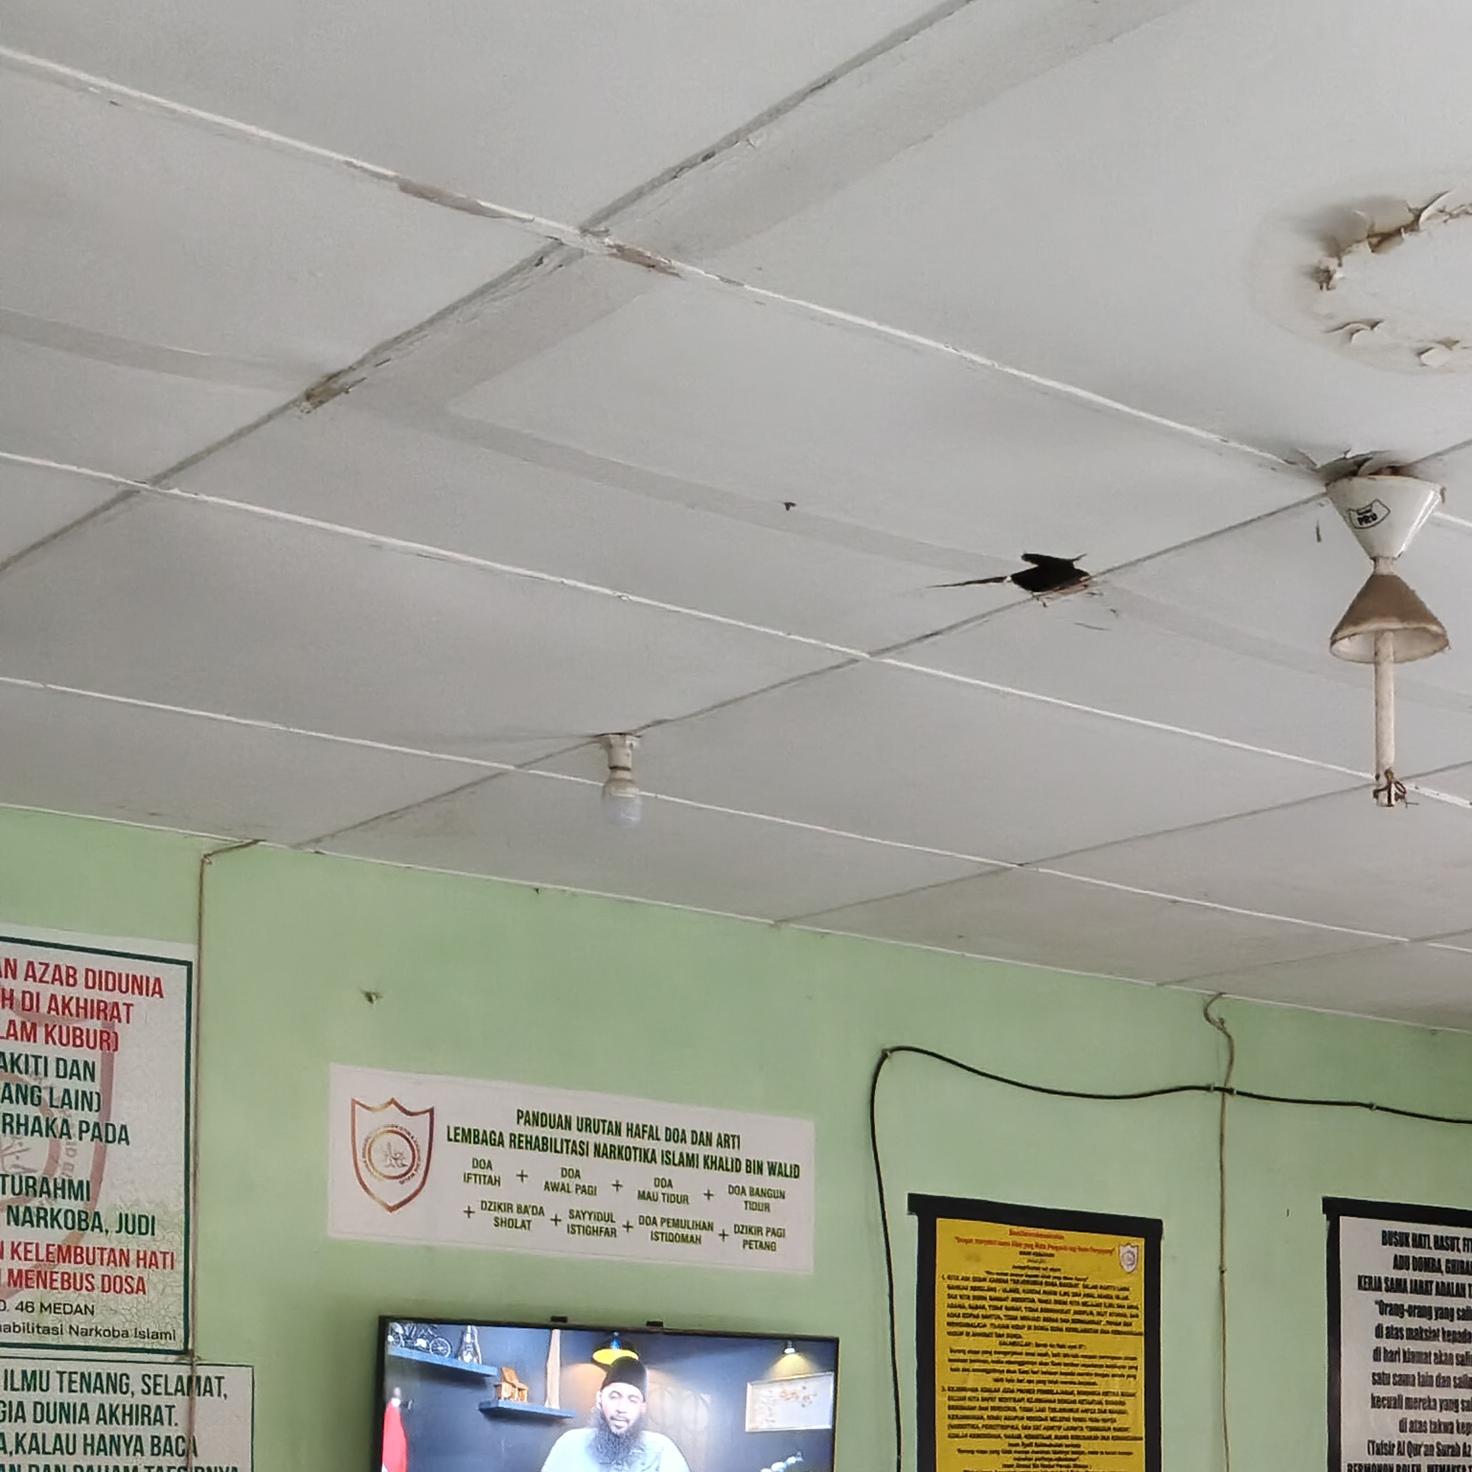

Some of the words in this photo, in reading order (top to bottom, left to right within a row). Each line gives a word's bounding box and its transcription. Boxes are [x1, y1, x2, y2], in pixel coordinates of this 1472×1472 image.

[24, 960, 77, 987] AZAB
[85, 968, 164, 998] DIDUNIA
[22, 990, 40, 1012] DI
[47, 993, 134, 1024] AKHIRAT
[45, 1023, 119, 1052] KUBUR)
[56, 1057, 95, 1082] DAN
[1, 1083, 41, 1106] ANG
[49, 1087, 101, 1112] LAIN)
[2, 1113, 71, 1139] RHAKA
[79, 1120, 129, 1145] PADA
[517, 1109, 571, 1131] PANDUAN
[577, 1116, 621, 1137] URUTAN
[626, 1122, 660, 1141] HAFAL
[665, 1127, 687, 1144] DOA
[691, 1130, 712, 1147] DAN
[716, 1134, 740, 1150] ARTI
[447, 1126, 504, 1148] LEMBAGA
[509, 1133, 589, 1156] REHABILITASI
[594, 1142, 657, 1164] NARKOTIKA
[661, 1150, 699, 1169] ISLAMI
[704, 1154, 741, 1173] KHALID
[746, 1159, 763, 1175] BIN
[768, 1161, 800, 1179] WALID
[464, 1172, 500, 1187] IFTITAH
[544, 1181, 571, 1193] AWAL
[575, 1184, 597, 1196] PAGI
[638, 1190, 658, 1202] MAU
[662, 1193, 689, 1205] TIDUR
[744, 1200, 770, 1212] TIDUR
[472, 1158, 492, 1170] DOA
[561, 1167, 581, 1180] DOA
[654, 1177, 673, 1189] DOA
[728, 1184, 746, 1196] DOA
[749, 1186, 786, 1199] BANGUN
[7, 1205, 109, 1235] NARKOBA,
[115, 1213, 155, 1236] JUDI
[481, 1200, 513, 1213] DZIKIR
[517, 1204, 545, 1216] BA'DA
[569, 1209, 615, 1223] SAYYIDUL
[639, 1215, 657, 1226] DOA
[661, 1217, 714, 1231] PEMULIHAN
[734, 1224, 763, 1237] DZIKIR
[766, 1226, 785, 1238] PAGI
[494, 1217, 532, 1230] SHOLAT
[567, 1224, 617, 1238] ISTIGHFAR
[743, 1239, 777, 1251] PETANG
[11, 1241, 130, 1267] KELEMBUTAN
[136, 1250, 174, 1269] HATI
[1393, 1254, 1410, 1271] ADU
[8, 1269, 94, 1292] MENEBUS
[101, 1274, 146, 1295] DOSA
[15, 1301, 34, 1313] 46
[40, 1303, 94, 1316] MEDAN
[1434, 1307, 1454, 1322] yang
[69, 1325, 129, 1339] Narkoba
[134, 1328, 176, 1341] Islami
[1386, 1325, 1404, 1339] atas
[4, 1369, 50, 1393] ILMU
[56, 1371, 135, 1398] TENANG,
[141, 1373, 227, 1400] SELAMAT,
[33, 1402, 90, 1424] DUNIA
[96, 1404, 179, 1426] AKHIRAT.
[84, 1434, 144, 1457] HANYA
